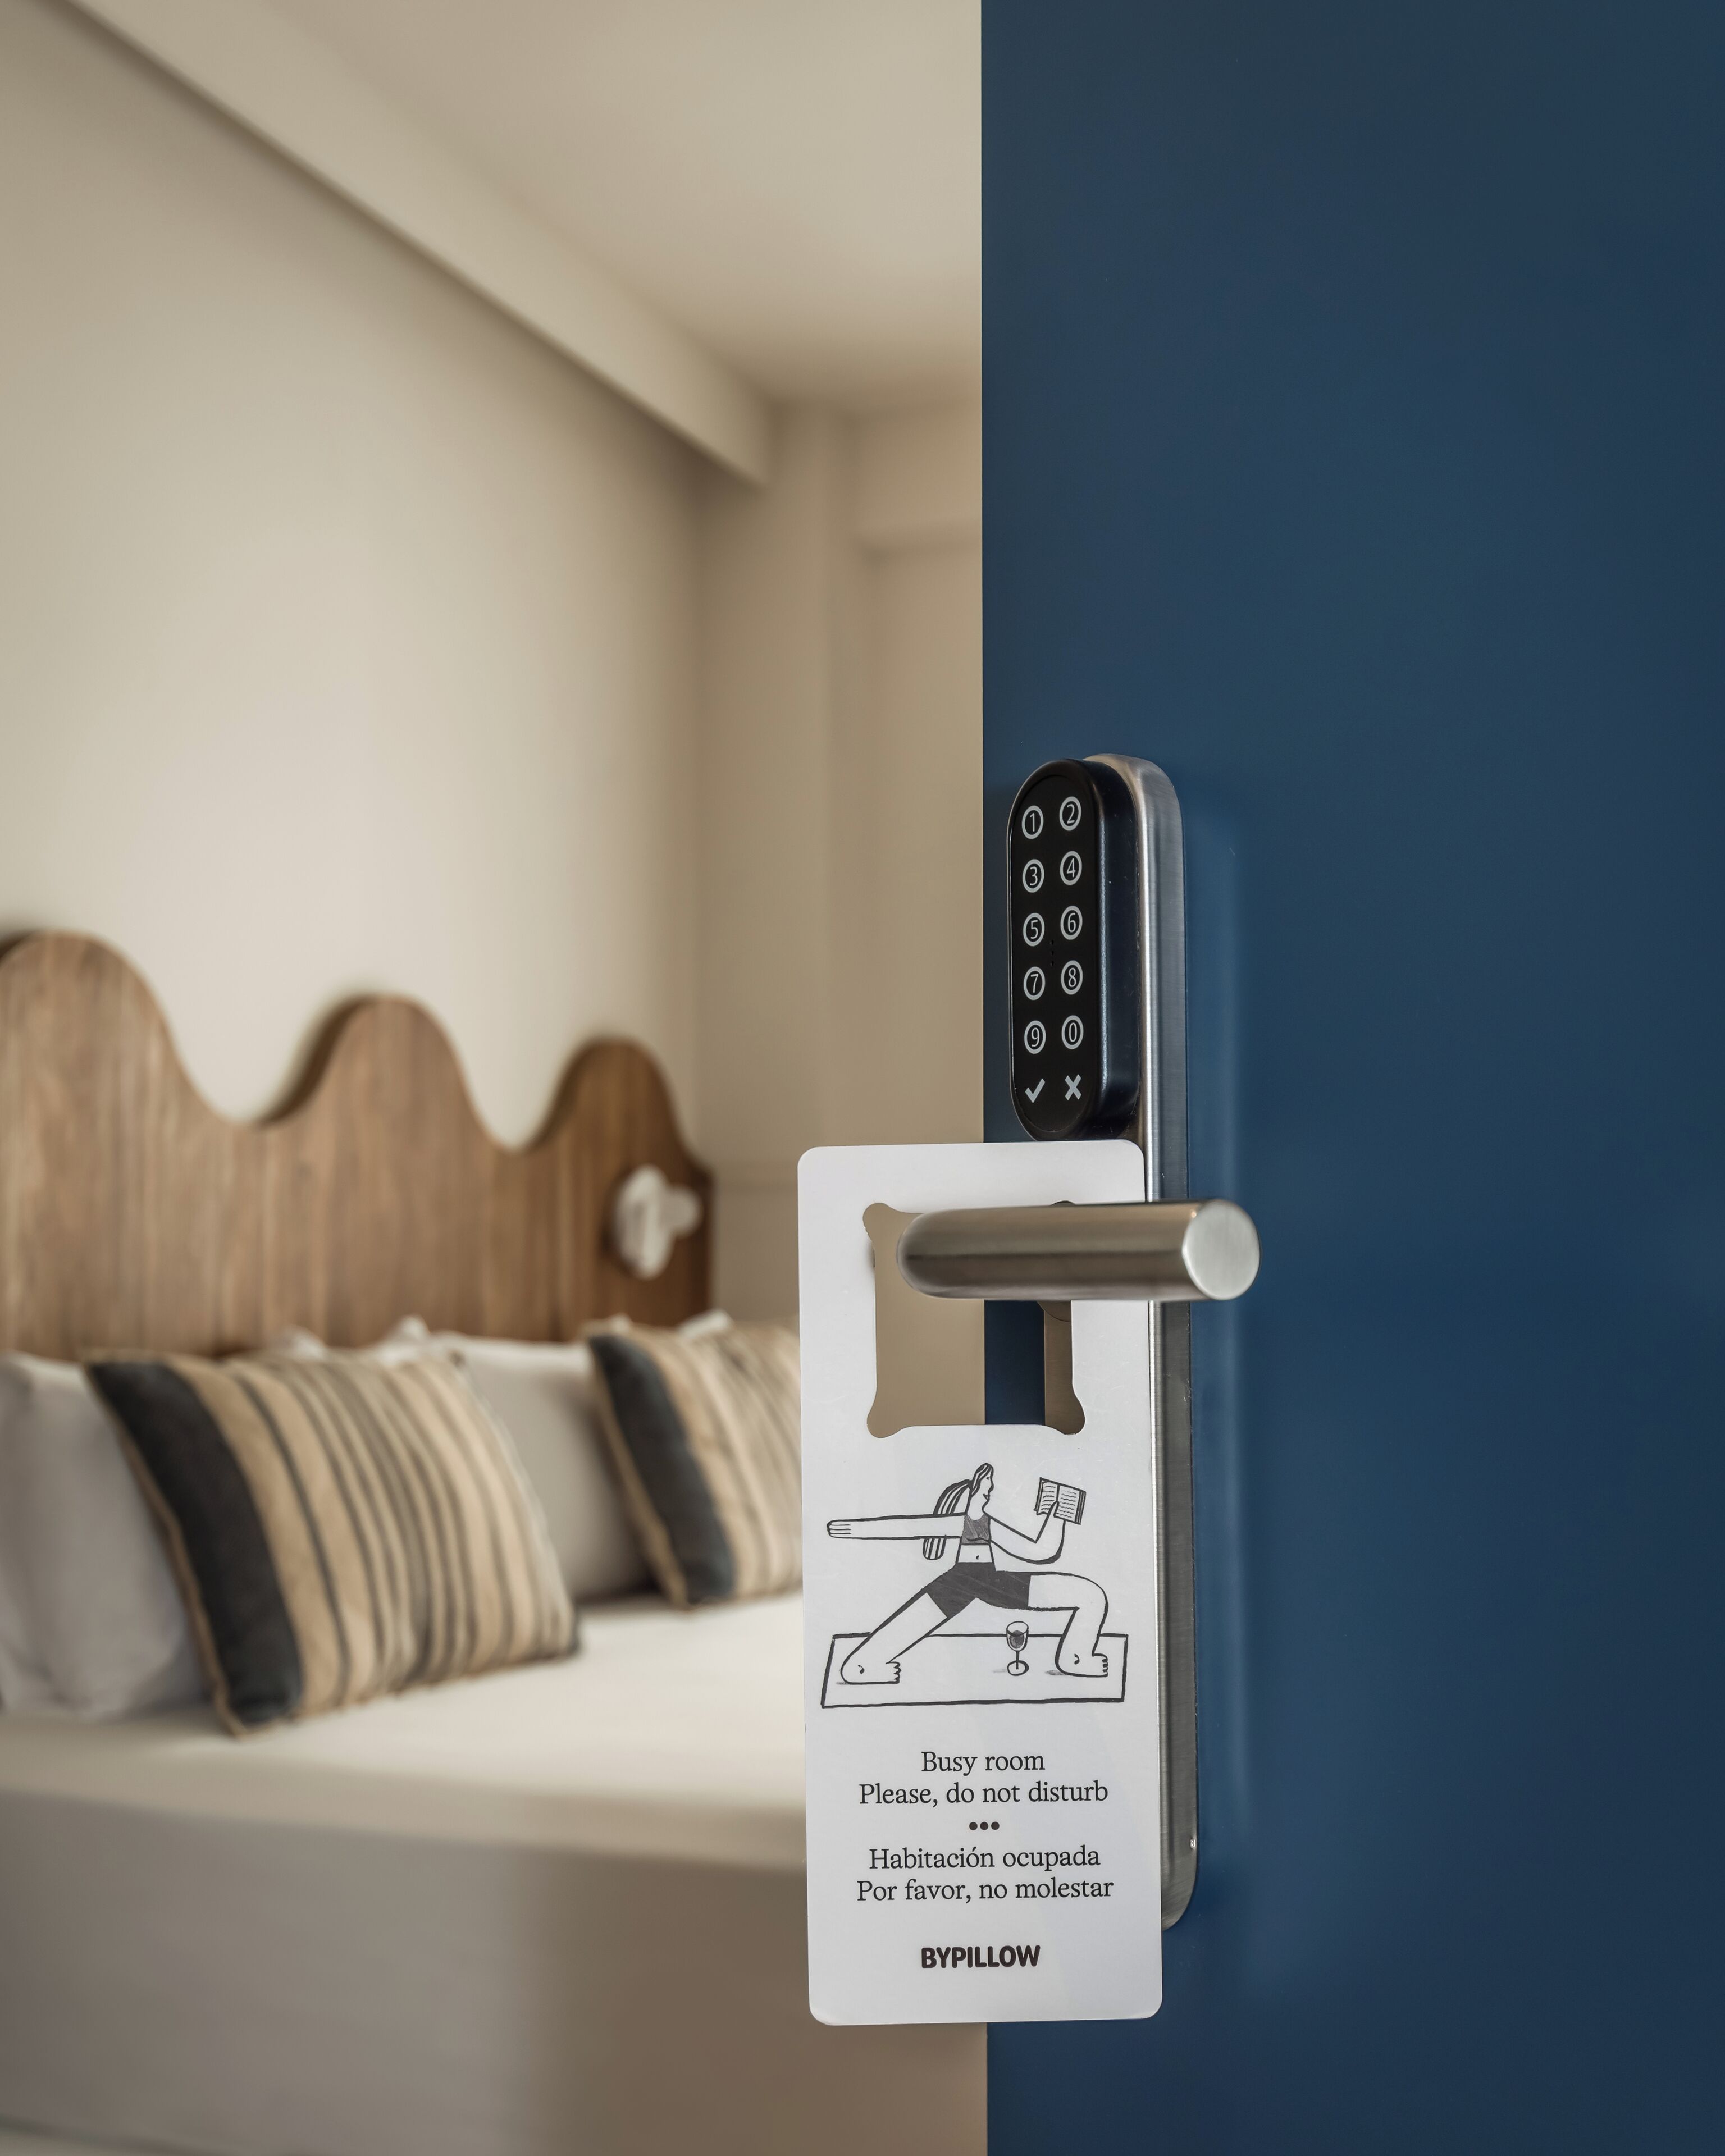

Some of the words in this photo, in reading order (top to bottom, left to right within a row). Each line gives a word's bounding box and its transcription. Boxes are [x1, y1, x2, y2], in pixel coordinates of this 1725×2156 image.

[921, 1751, 978, 1776] Busy
[984, 1755, 1046, 1771] room
[859, 1782, 938, 1808] Please,
[946, 1782, 975, 1803] do
[982, 1785, 1020, 1803] not
[1028, 1779, 1108, 1802] disturb
[869, 1846, 996, 1869] Habitación
[1002, 1844, 1101, 1872] ocupada
[857, 1880, 898, 1901] Por
[905, 1878, 971, 1904] favor,
[979, 1884, 1007, 1899] no
[1015, 1876, 1114, 1898] molestar
[921, 1945, 1041, 1969] BYPILLOW
